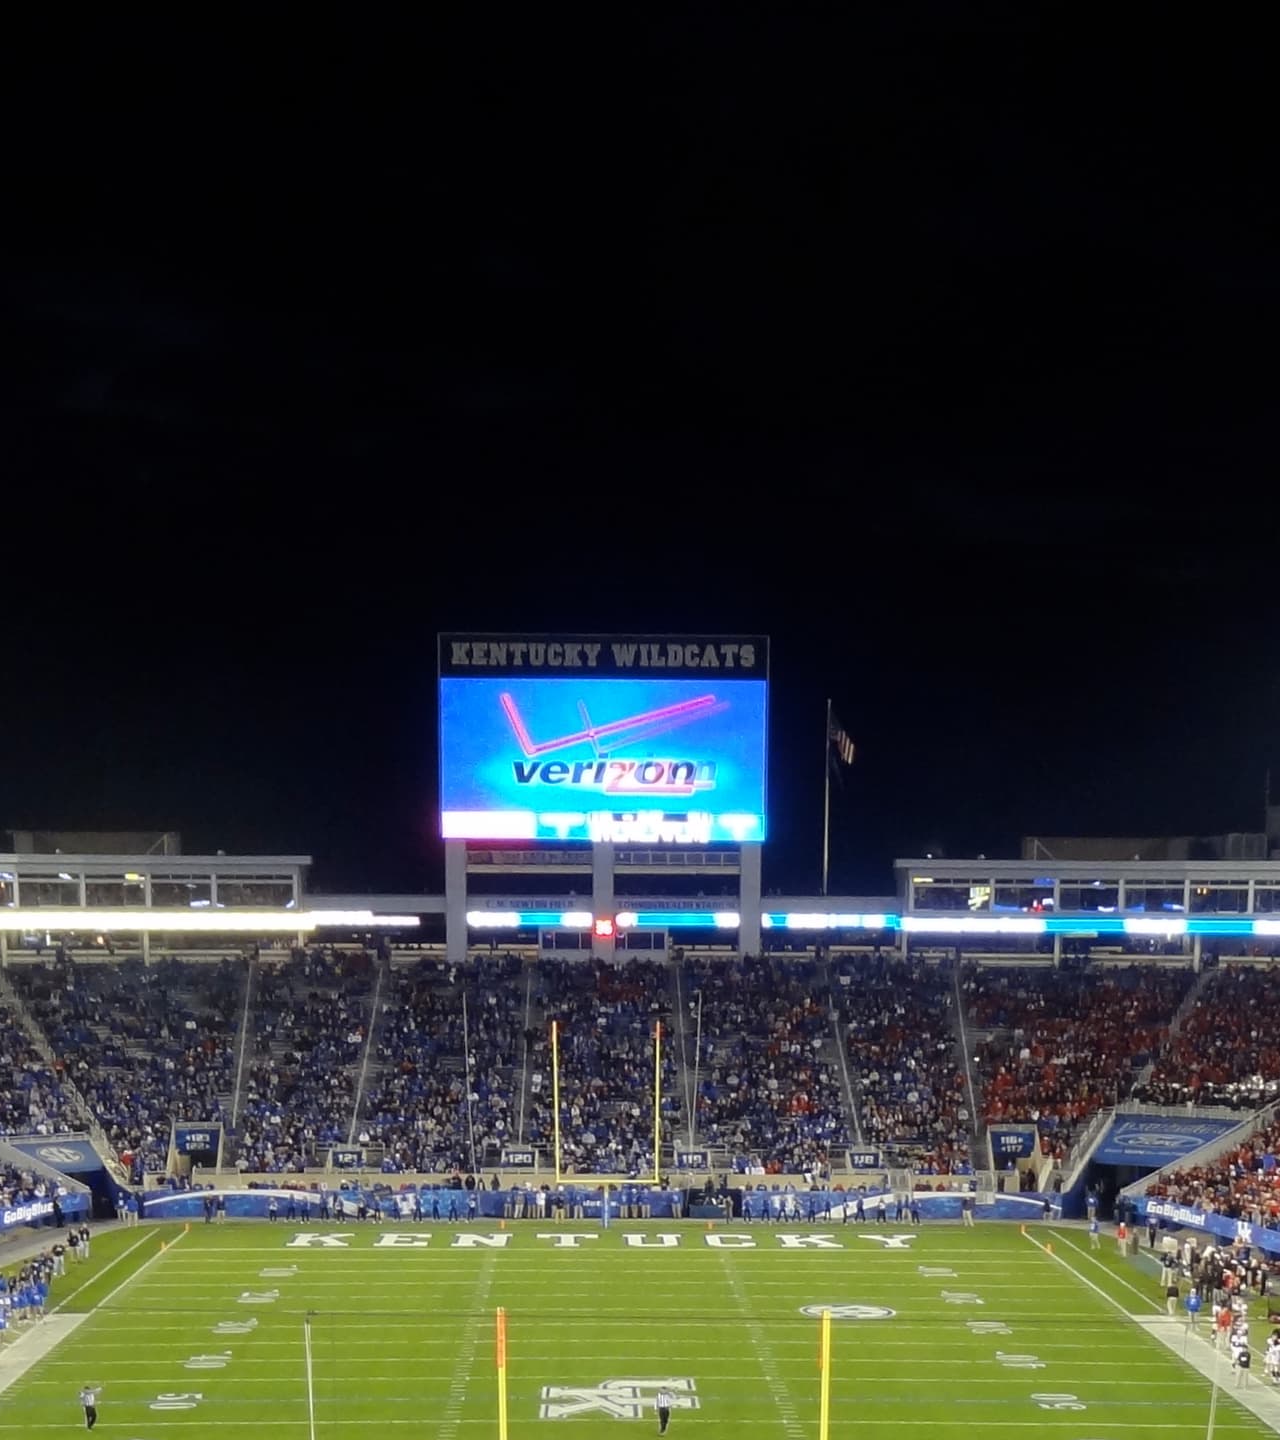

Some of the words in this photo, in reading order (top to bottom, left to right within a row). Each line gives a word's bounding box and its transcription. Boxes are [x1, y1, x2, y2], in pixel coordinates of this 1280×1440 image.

[451, 642, 601, 666] KENTUCKY
[611, 643, 755, 667] WILDCATS
[513, 753, 702, 795] verizon
[508, 1153, 532, 1163] 120
[1146, 1201, 1206, 1226] GoBigBlue!
[286, 1232, 917, 1249] KENTUCKY
